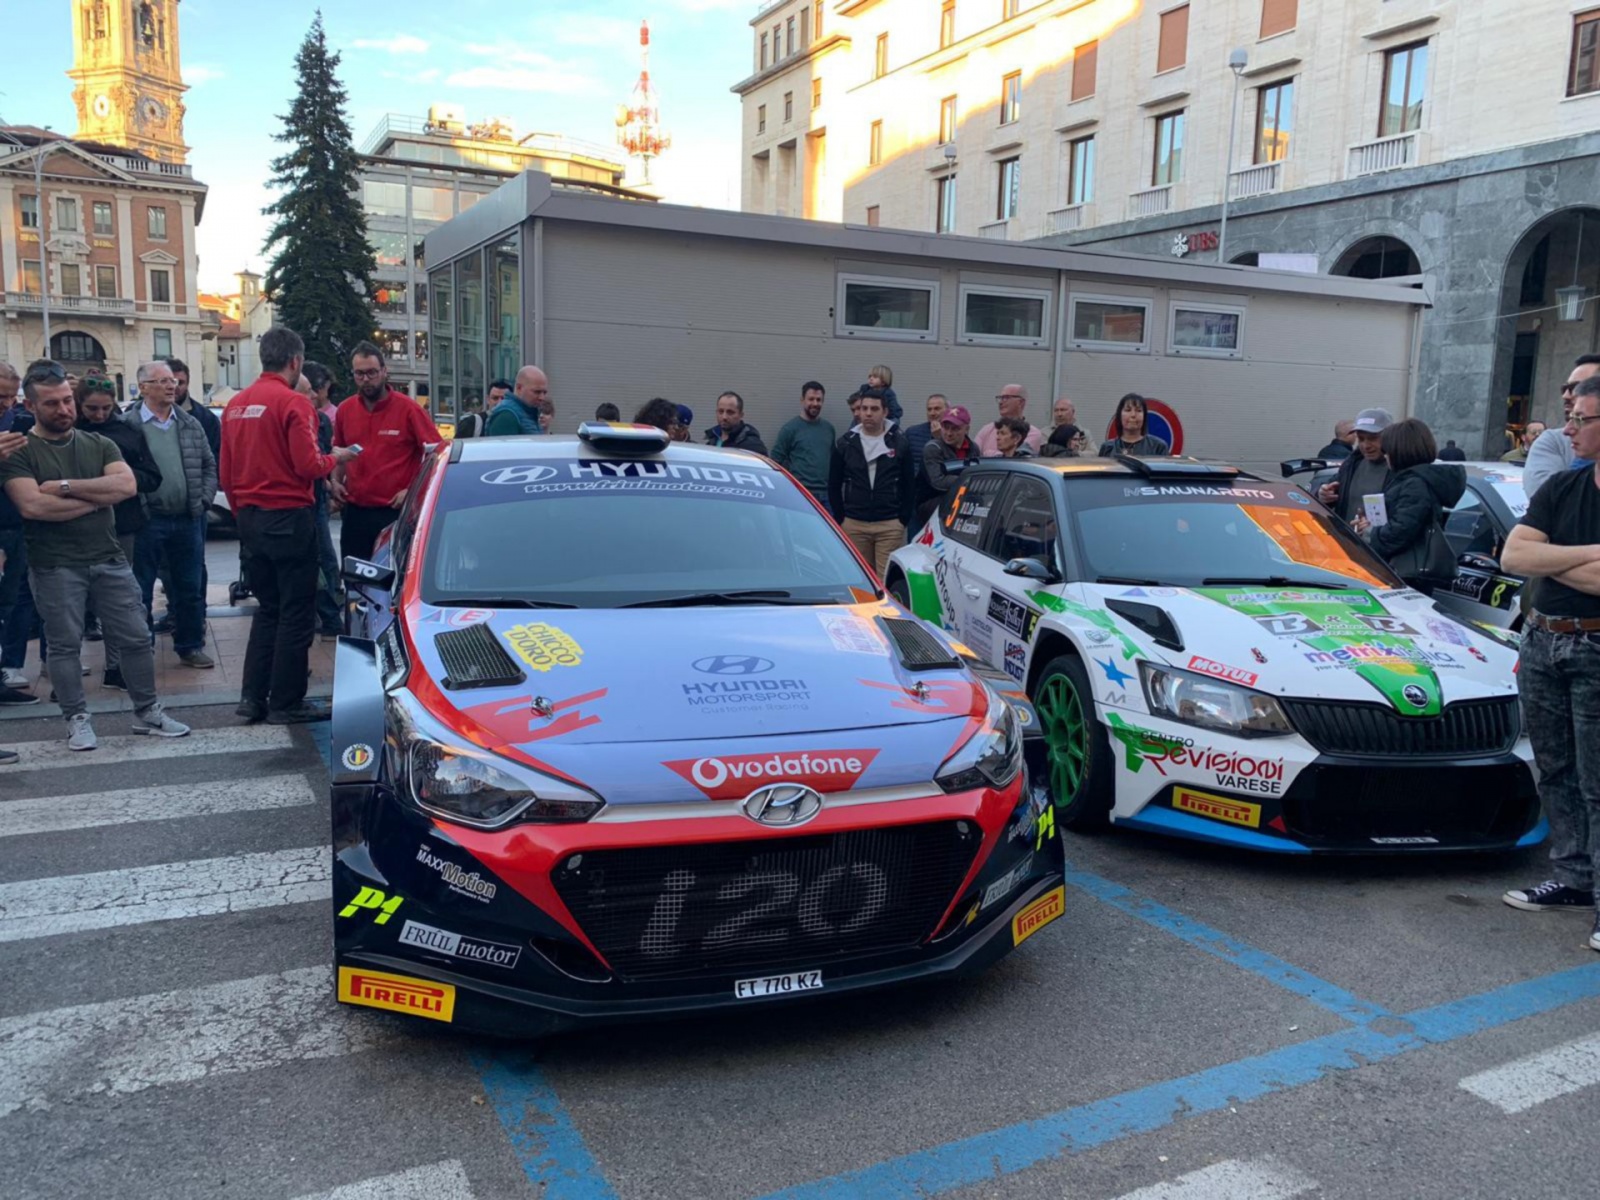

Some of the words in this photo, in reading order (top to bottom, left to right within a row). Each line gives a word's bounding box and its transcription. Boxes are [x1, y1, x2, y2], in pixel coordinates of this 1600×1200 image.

[568, 461, 776, 490] HYUNDAI
[524, 479, 766, 499] www.friulmotor.com
[1160, 486, 1275, 499] MUNARETTO
[945, 485, 967, 528] 5
[355, 562, 379, 578] TO
[1490, 583, 1507, 607] 8
[459, 610, 486, 622] E
[527, 624, 577, 664] CHICCO
[1192, 657, 1254, 684] MOTUL
[681, 679, 808, 695] HYUNDAI
[687, 691, 812, 706] MOTORSPORT
[700, 703, 763, 714] Customer
[1140, 730, 1195, 748] CENTRO
[726, 754, 863, 779] vodafone
[1215, 773, 1281, 794] VARESE
[1180, 792, 1252, 822] PIRELLI
[338, 885, 405, 925] P1
[1017, 893, 1059, 938] PIRELLI
[350, 974, 445, 1013] PIRELLI
[737, 980, 758, 997] FT
[763, 975, 792, 994] 770
[797, 972, 820, 989] KZ
